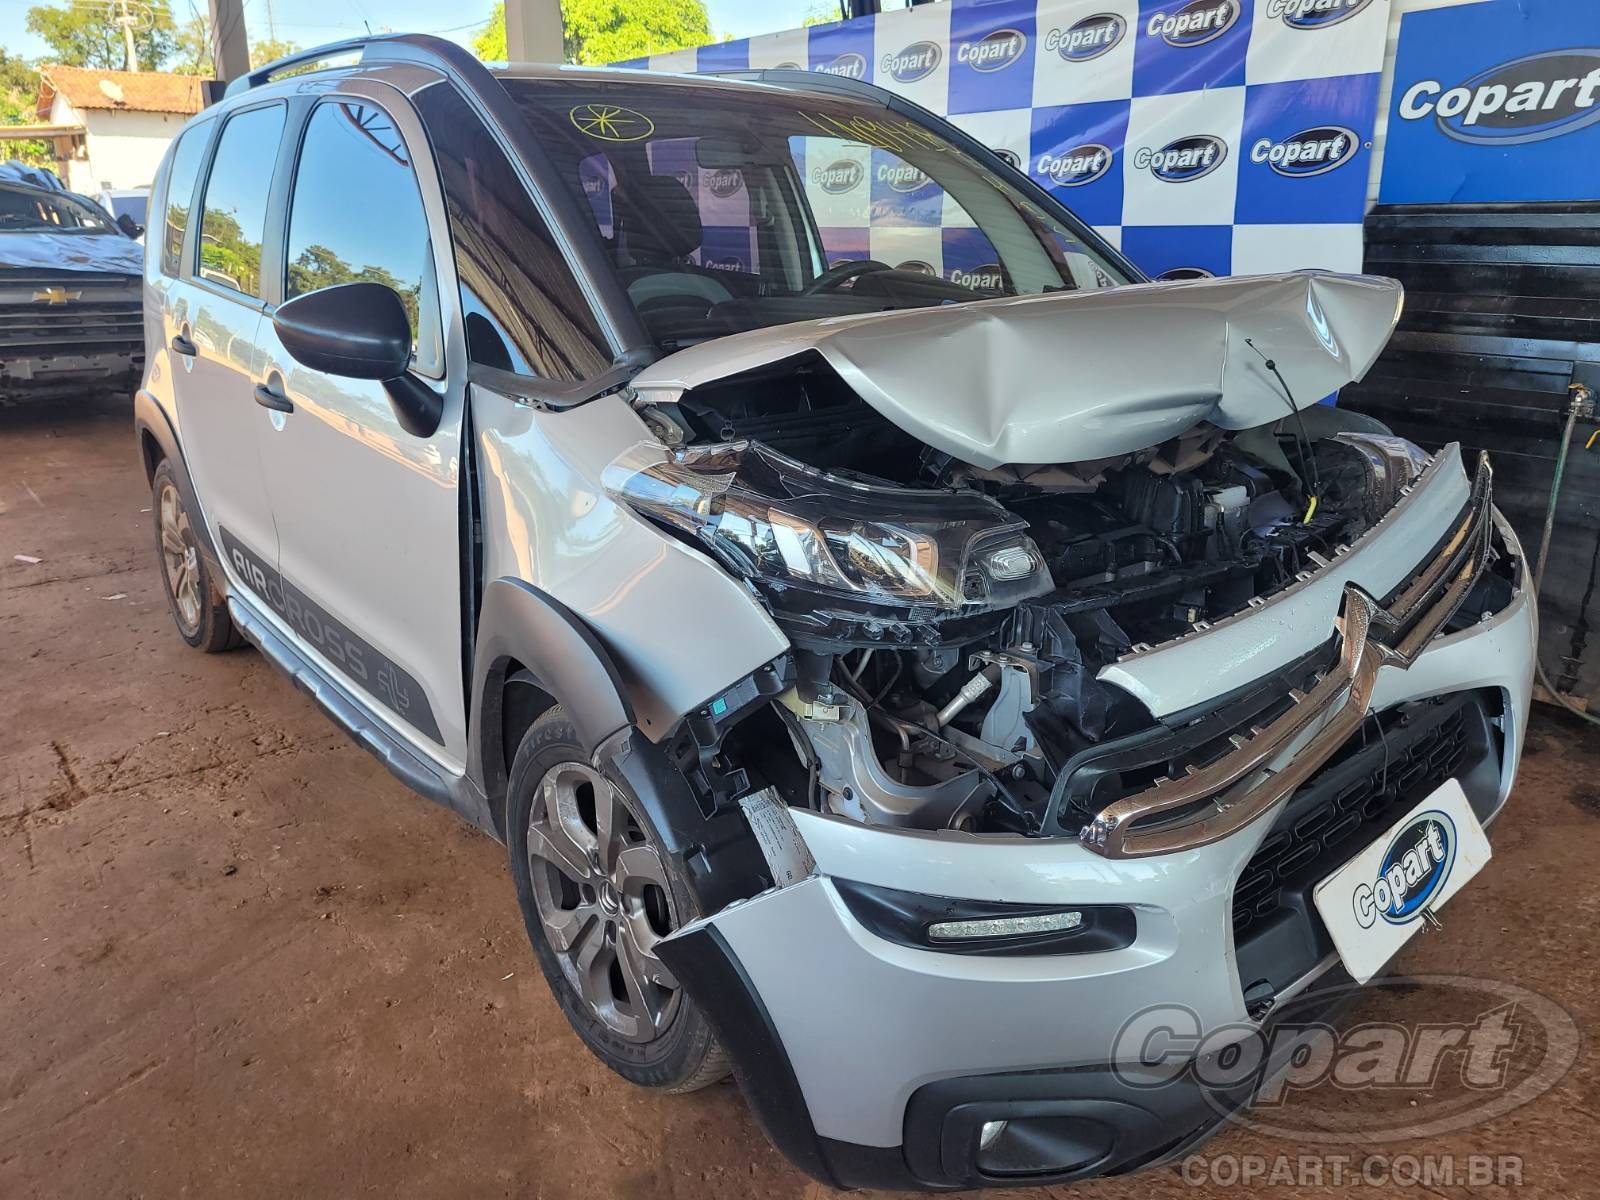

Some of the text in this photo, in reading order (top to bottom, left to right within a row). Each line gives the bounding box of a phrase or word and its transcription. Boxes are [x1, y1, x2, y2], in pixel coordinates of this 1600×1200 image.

[1146, 1, 1232, 38] Copart
[1266, 0, 1358, 20] Copa
[957, 33, 1018, 64] Copart
[1045, 18, 1118, 51] Copart
[881, 48, 934, 75] Copart
[1400, 67, 1600, 126] Copart
[1037, 145, 1106, 176] Copart
[1134, 138, 1219, 175] Copart
[1250, 130, 1350, 169] Copart
[703, 172, 739, 190] Copart
[812, 165, 858, 188] Copart
[1352, 818, 1448, 930] Copart
